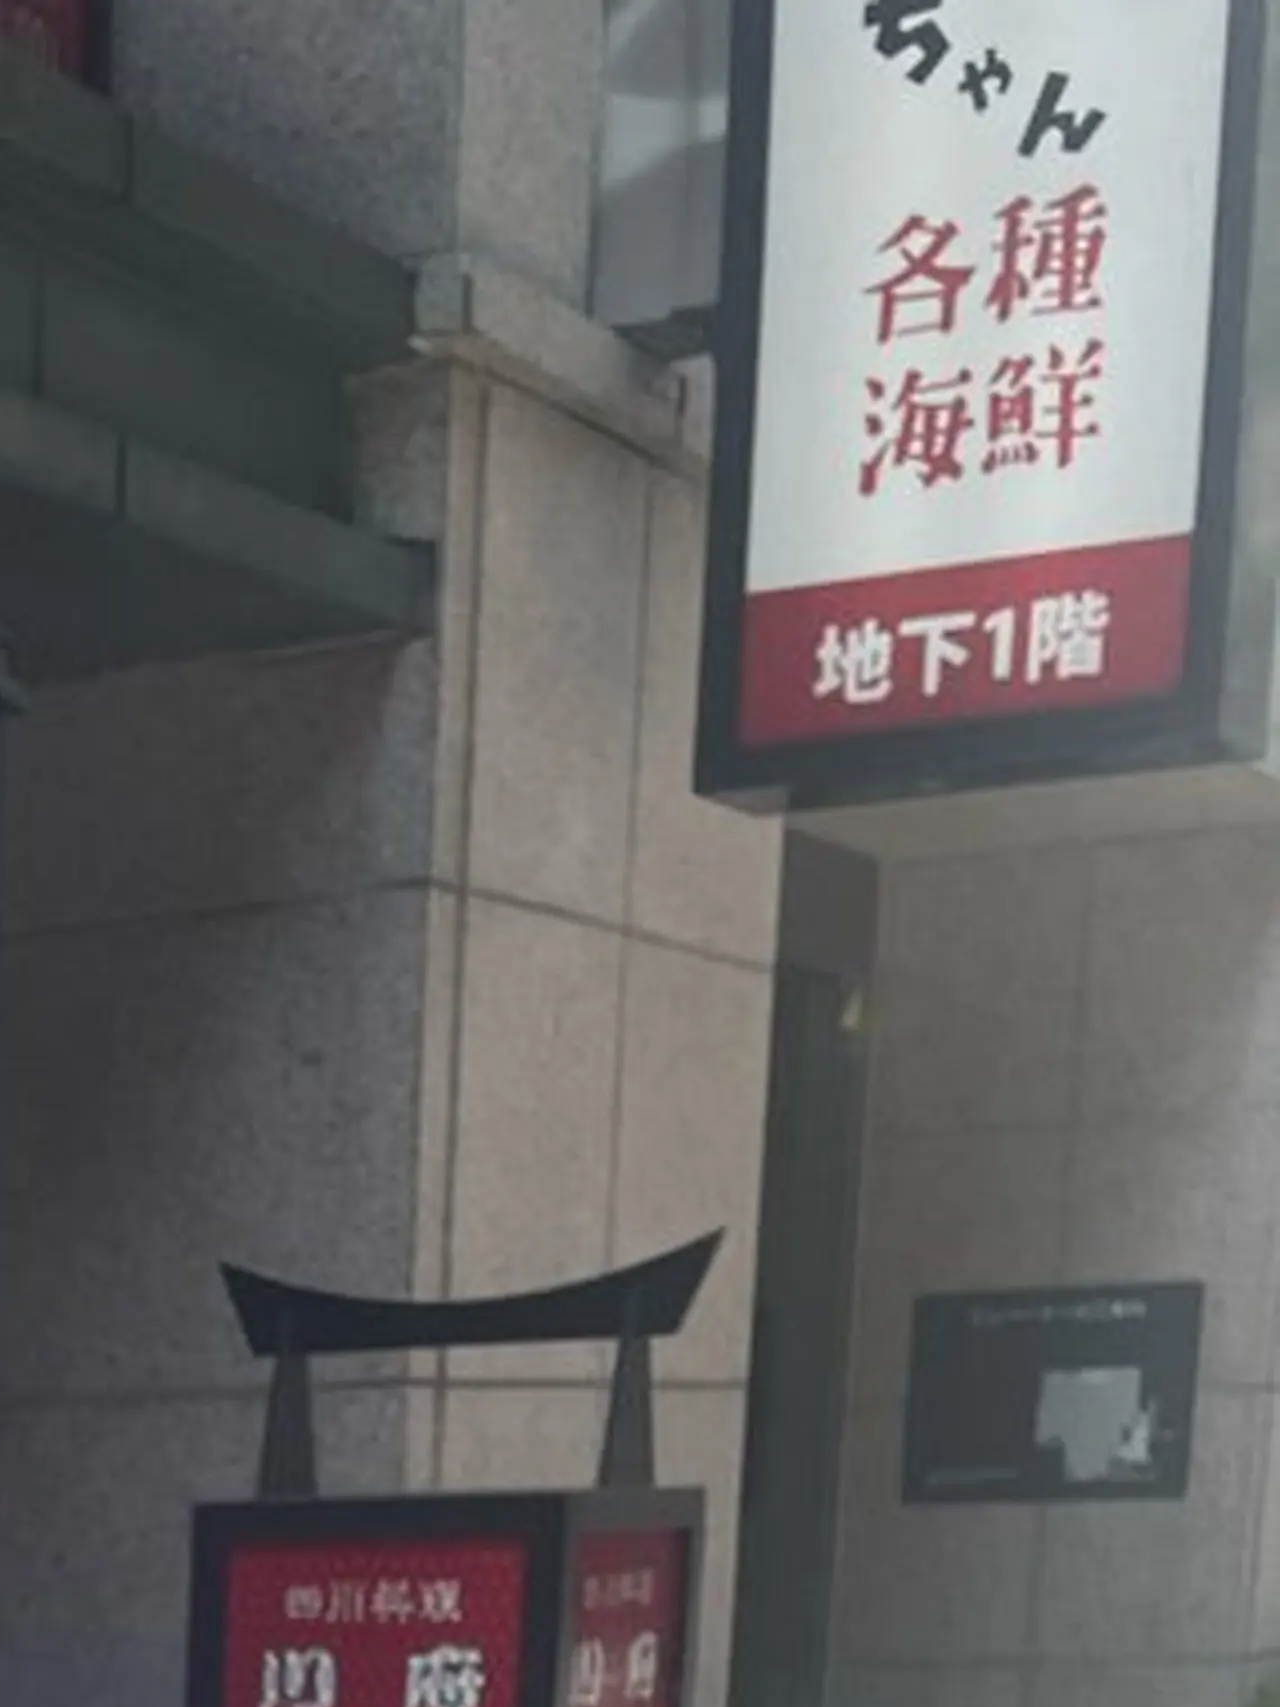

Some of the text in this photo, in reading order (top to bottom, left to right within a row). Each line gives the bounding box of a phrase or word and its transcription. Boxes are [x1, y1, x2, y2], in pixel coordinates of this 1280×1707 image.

[864, 0, 1107, 157] ちゃん
[863, 184, 1109, 346] 各種
[858, 339, 1105, 498] 海鮮
[812, 590, 1111, 704] 地下1階
